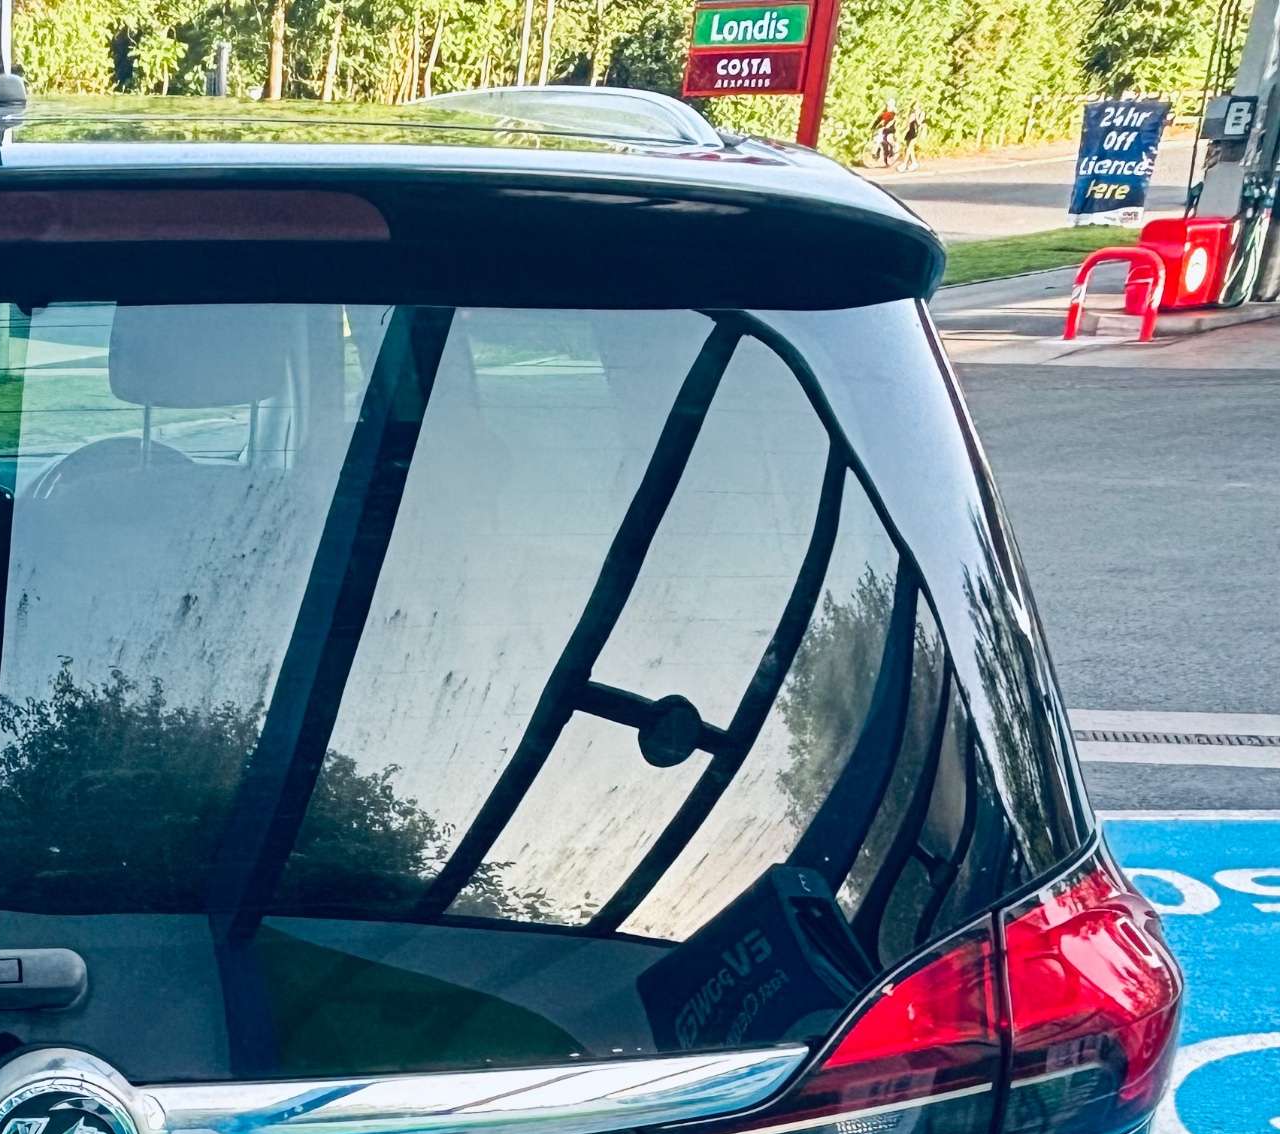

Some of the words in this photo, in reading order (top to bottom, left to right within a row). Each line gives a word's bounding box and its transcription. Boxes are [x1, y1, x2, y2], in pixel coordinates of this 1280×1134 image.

[710, 12, 790, 42] Londis
[716, 58, 772, 77] COSTA
[1100, 106, 1153, 128] 24hr
